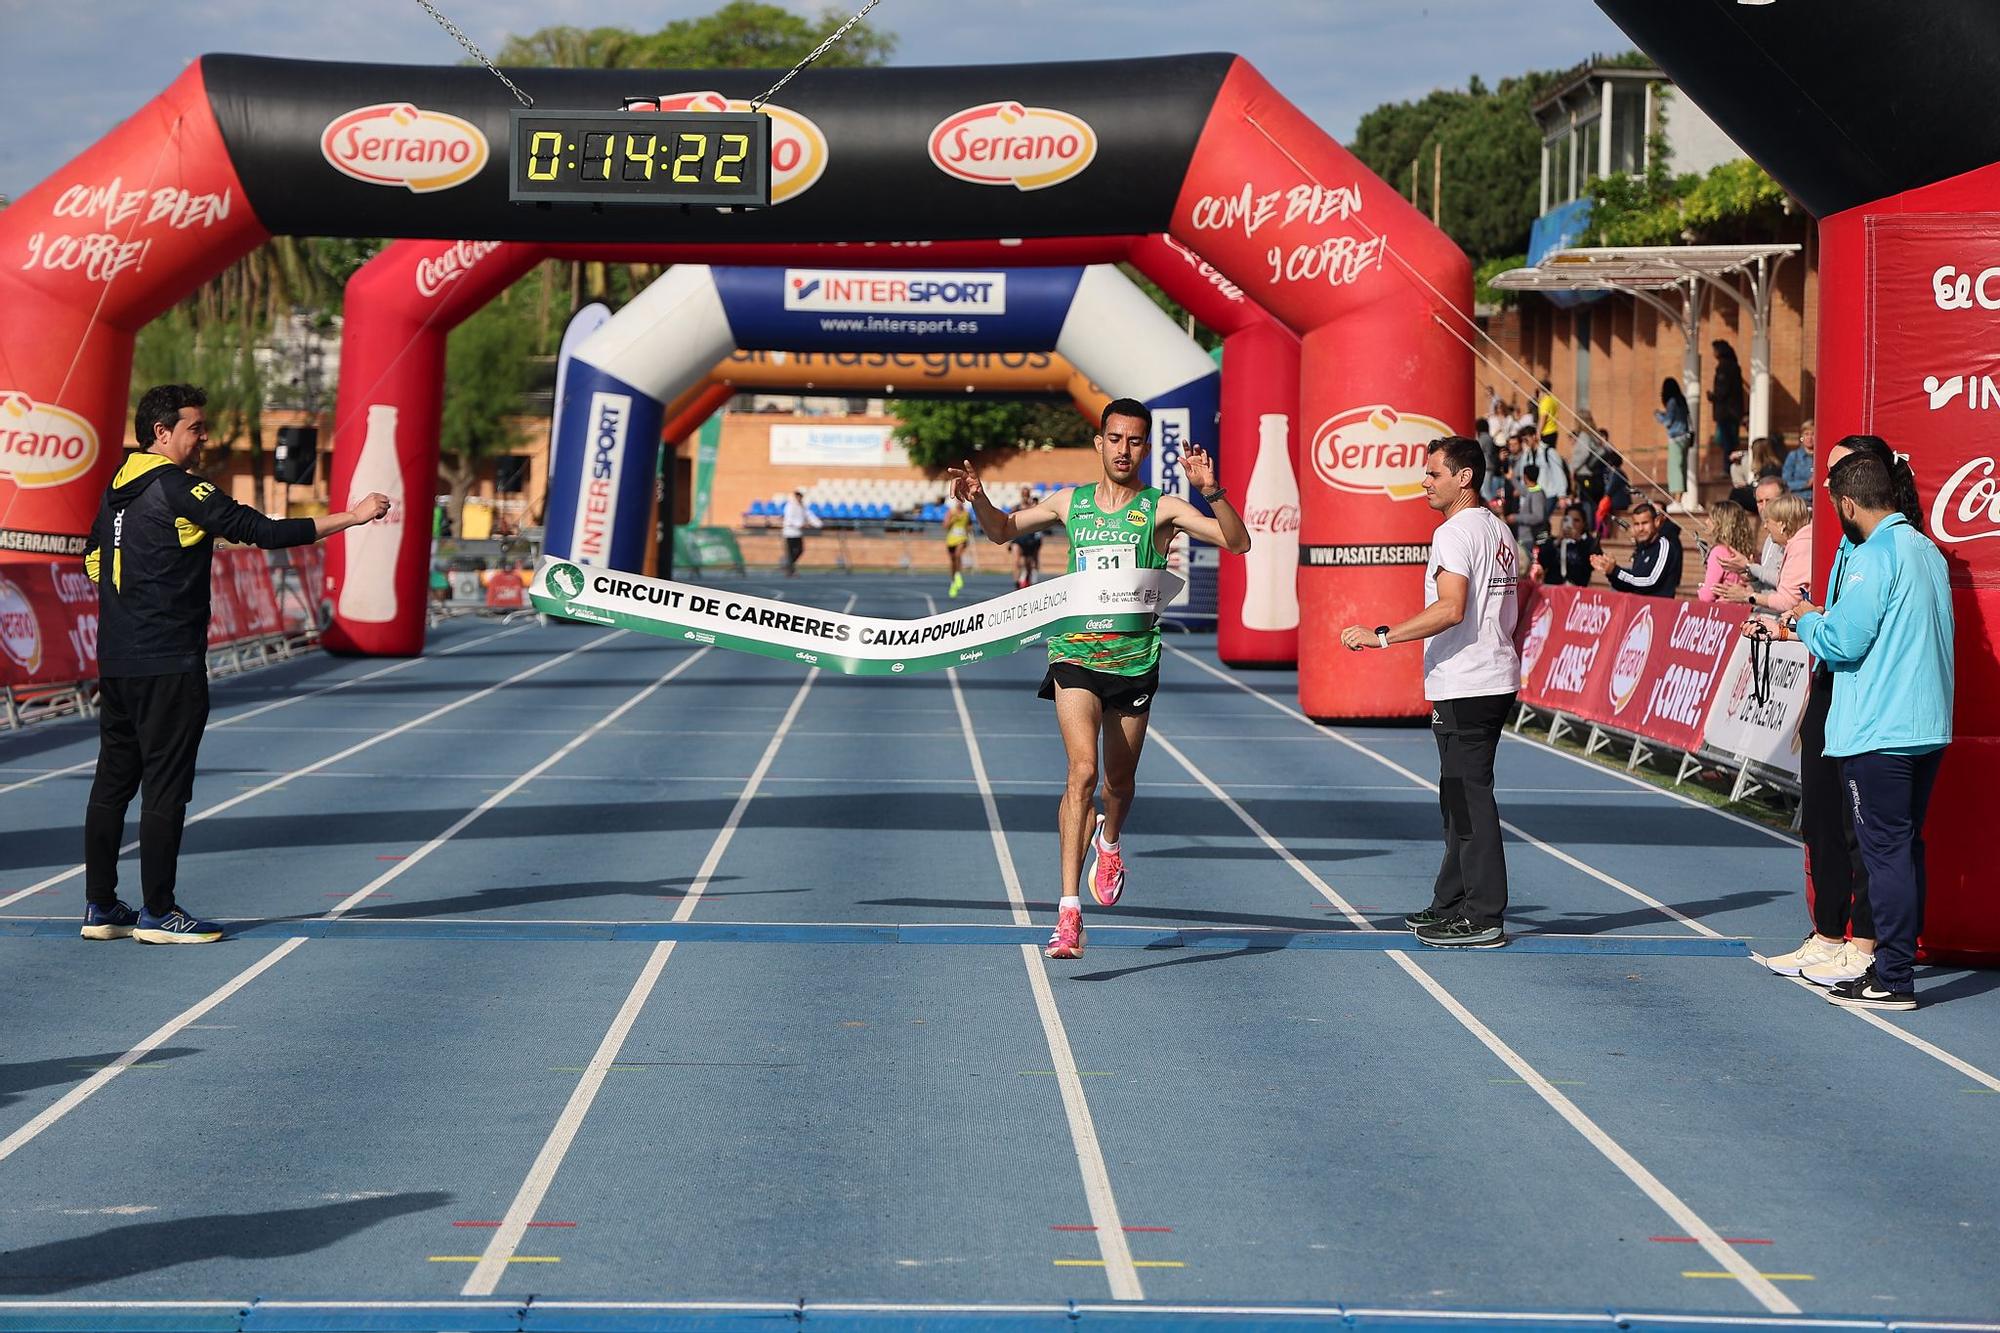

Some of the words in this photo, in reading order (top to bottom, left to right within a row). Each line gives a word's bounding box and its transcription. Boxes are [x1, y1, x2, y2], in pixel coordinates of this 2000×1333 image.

[340, 126, 470, 164] Serrano
[527, 131, 749, 183] 0:14:22
[948, 126, 1079, 164] Serrano
[52, 176, 147, 231] COME
[141, 185, 232, 229] BIEN
[1192, 183, 1281, 238] COME
[1278, 182, 1363, 229] BIEN
[42, 233, 152, 281] CORRE!
[1286, 234, 1388, 286] CORRE!
[825, 278, 993, 303] INTERSPORT
[820, 315, 979, 336] www.intersport.es
[1324, 434, 1428, 470] Serran
[581, 404, 620, 555] INTERSPORT
[1074, 526, 1142, 545] Huesca
[1097, 555, 1120, 570] 31
[593, 576, 685, 608] CIRCUIT
[689, 595, 721, 617] DE
[725, 603, 851, 642] CARRERES
[987, 608, 1018, 629] CIUTAT
[1017, 604, 1028, 620] DE
[1028, 590, 1068, 616] VALÈNCIA
